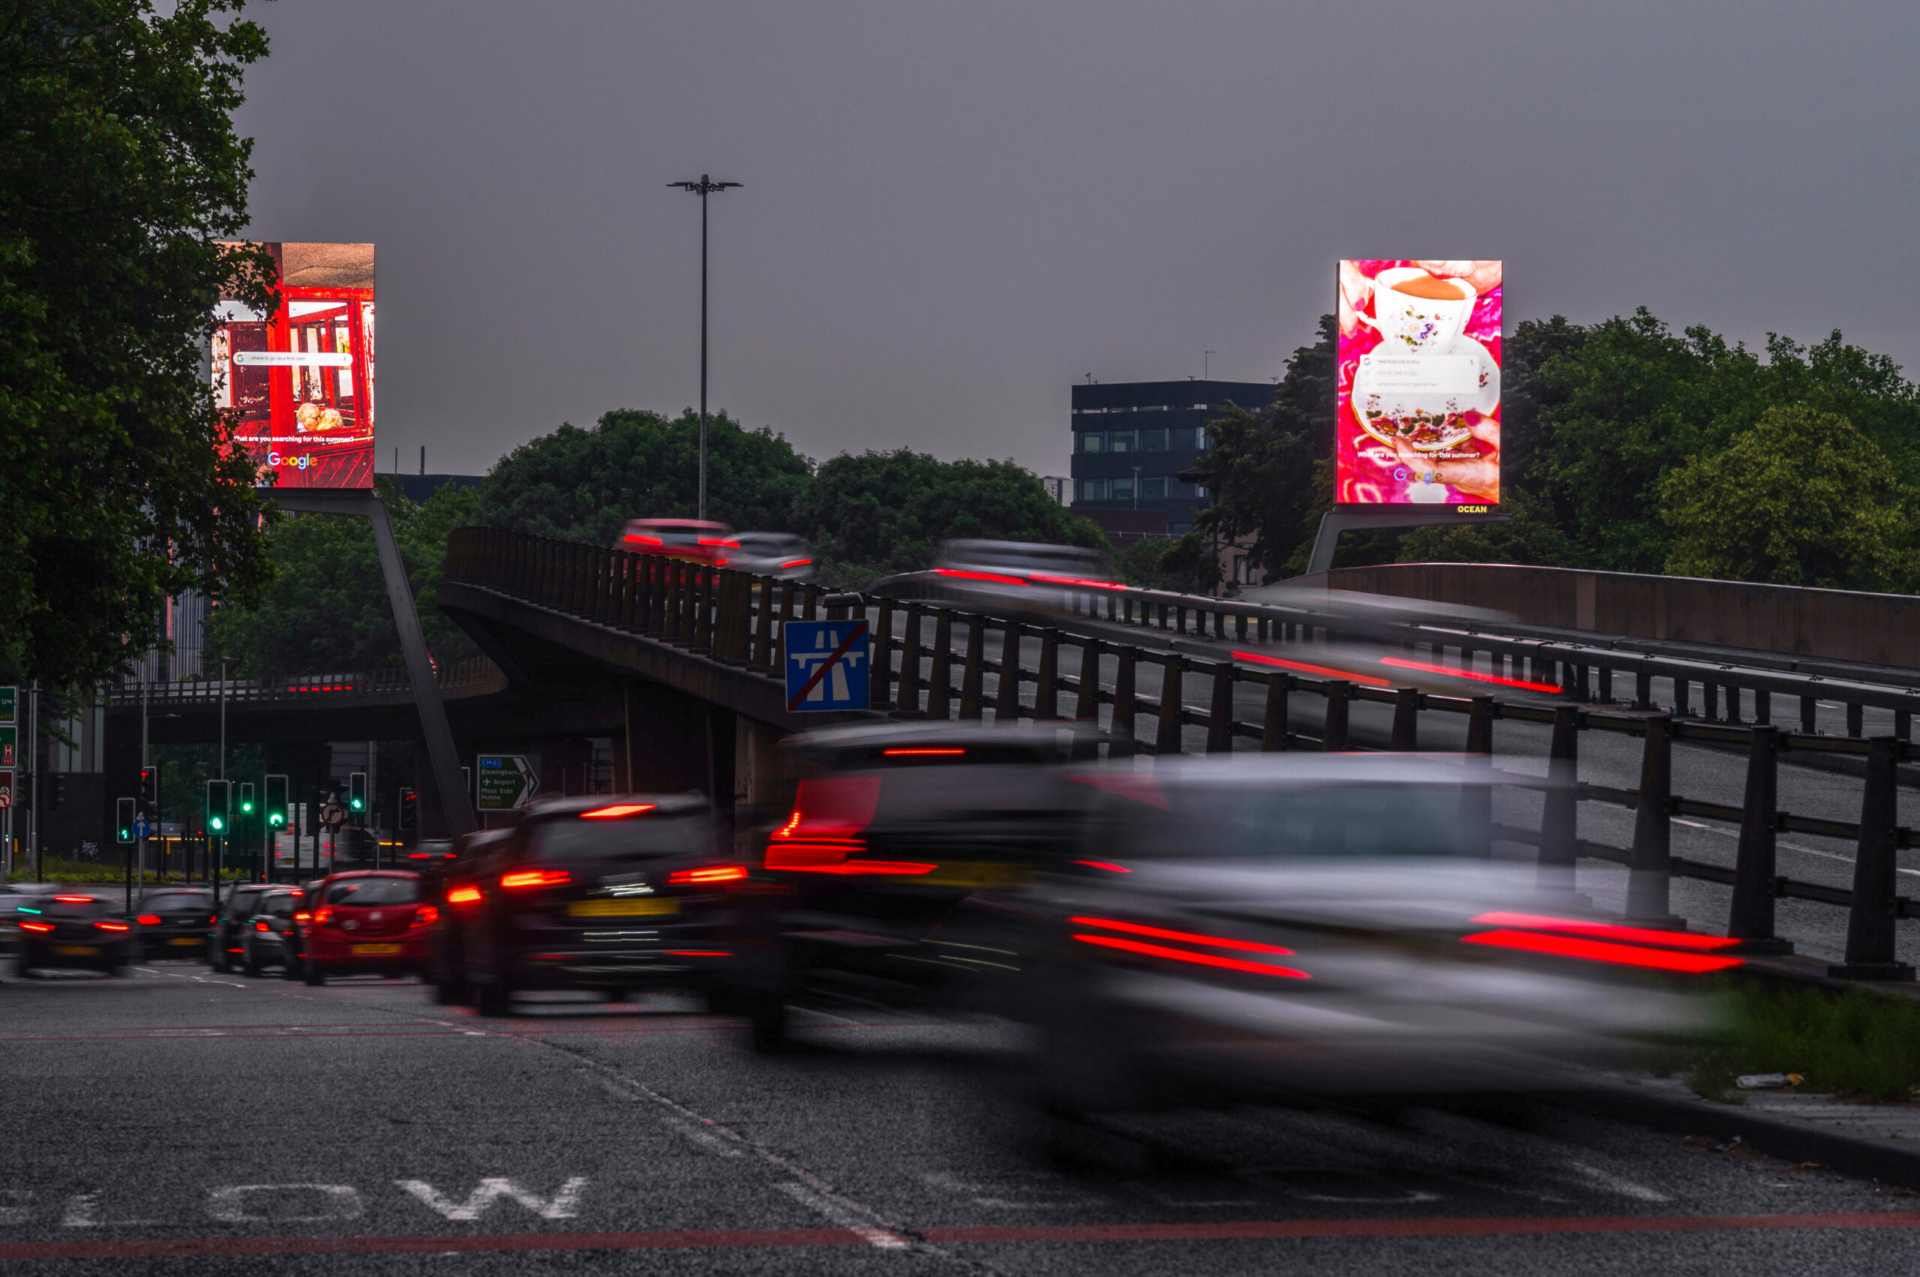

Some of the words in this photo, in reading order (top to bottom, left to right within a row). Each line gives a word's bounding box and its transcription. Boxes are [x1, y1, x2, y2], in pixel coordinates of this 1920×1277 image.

[272, 435, 302, 443] searching
[1398, 451, 1428, 459] searching
[267, 452, 318, 470] Google
[1393, 468, 1443, 485] Google
[1457, 505, 1487, 513] OCEAN
